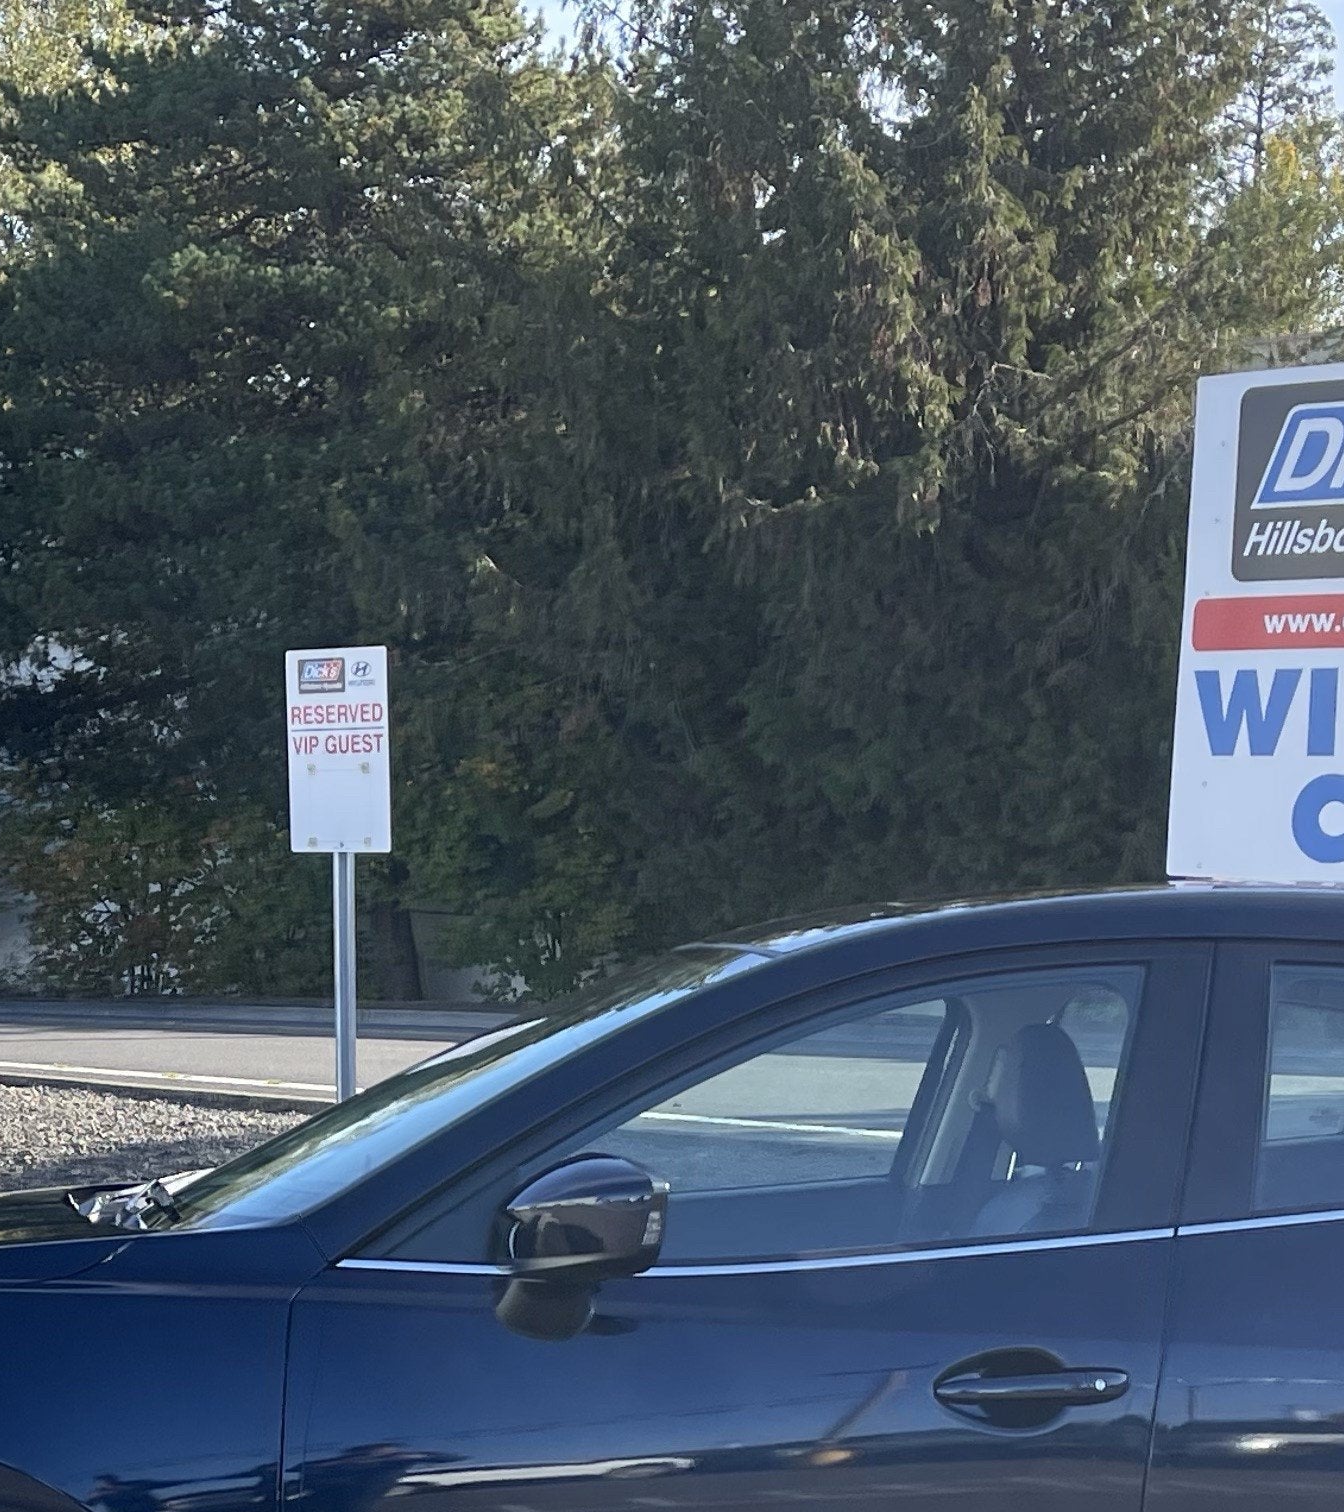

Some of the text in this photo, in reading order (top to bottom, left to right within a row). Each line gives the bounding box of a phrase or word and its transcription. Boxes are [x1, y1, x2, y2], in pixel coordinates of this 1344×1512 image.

[290, 702, 384, 726] RESERVED
[292, 733, 384, 755] VIP GUEST
